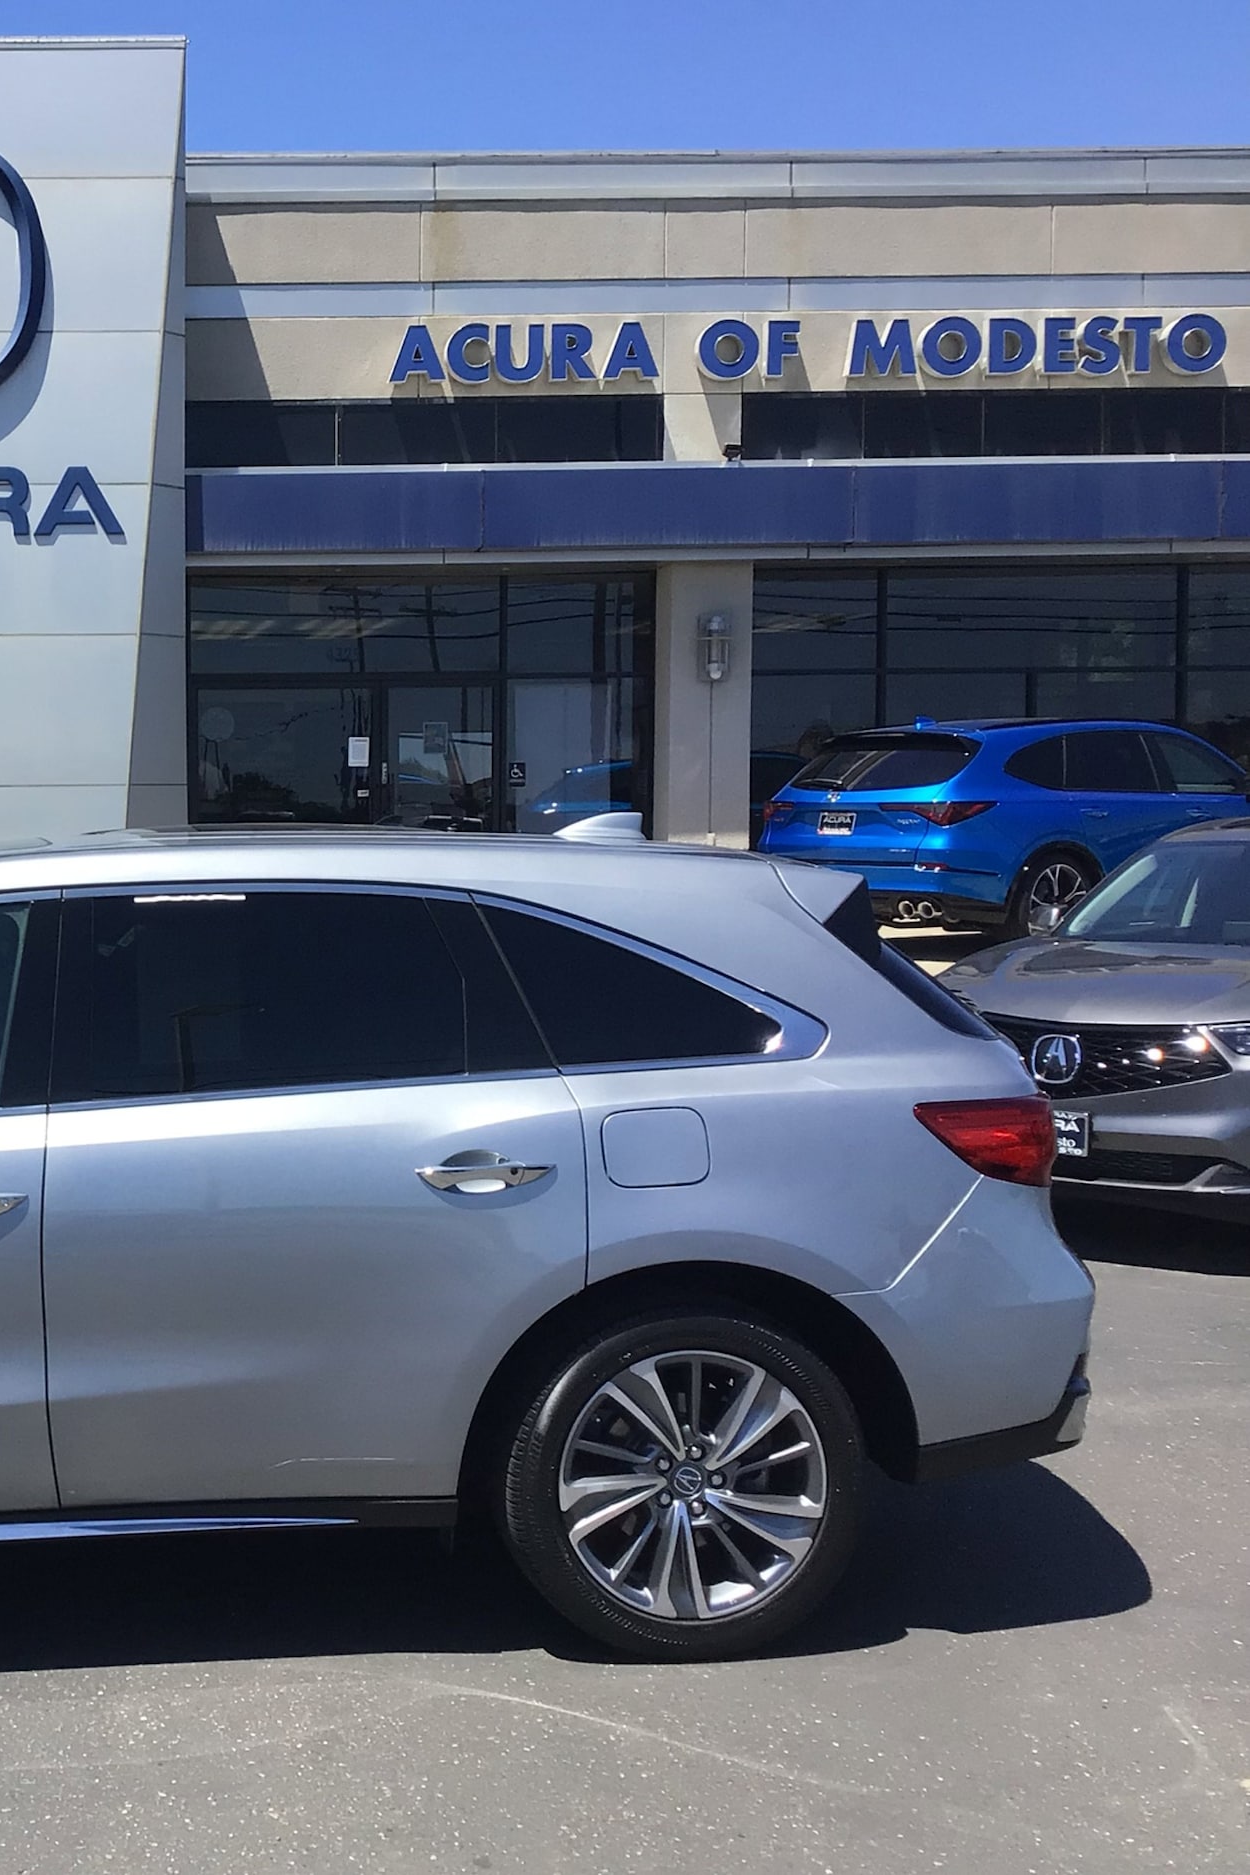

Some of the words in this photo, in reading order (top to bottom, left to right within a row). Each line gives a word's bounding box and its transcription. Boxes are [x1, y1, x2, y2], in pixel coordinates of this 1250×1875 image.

[388, 322, 661, 385] ACURA
[698, 318, 801, 381] OF
[846, 313, 1230, 379] MODESTO
[823, 816, 851, 824] ACURA
